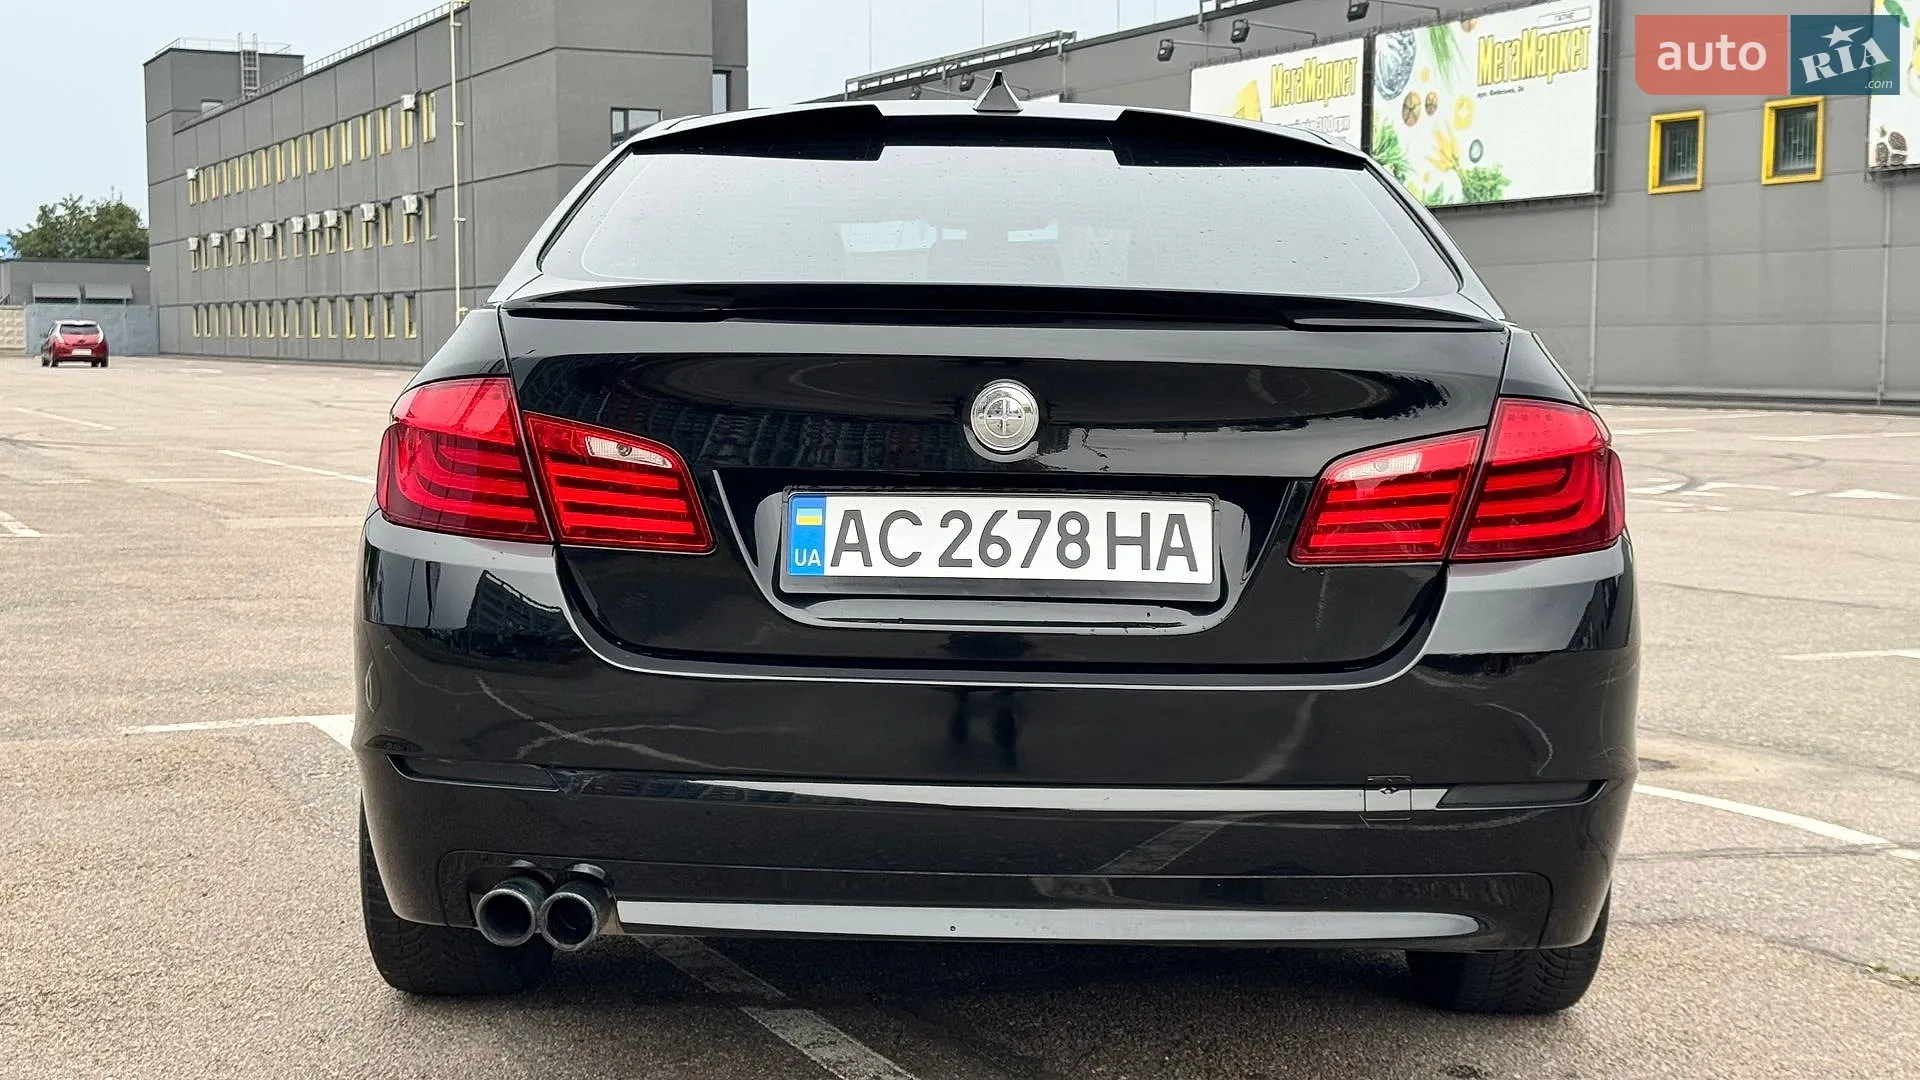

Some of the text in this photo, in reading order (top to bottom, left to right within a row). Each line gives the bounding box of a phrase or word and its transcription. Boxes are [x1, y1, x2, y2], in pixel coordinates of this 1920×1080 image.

[1270, 56, 1358, 108] МегаМаркет
[1477, 25, 1592, 87] МегаМаркет
[794, 509, 1199, 572] UA AC 2678 HA
